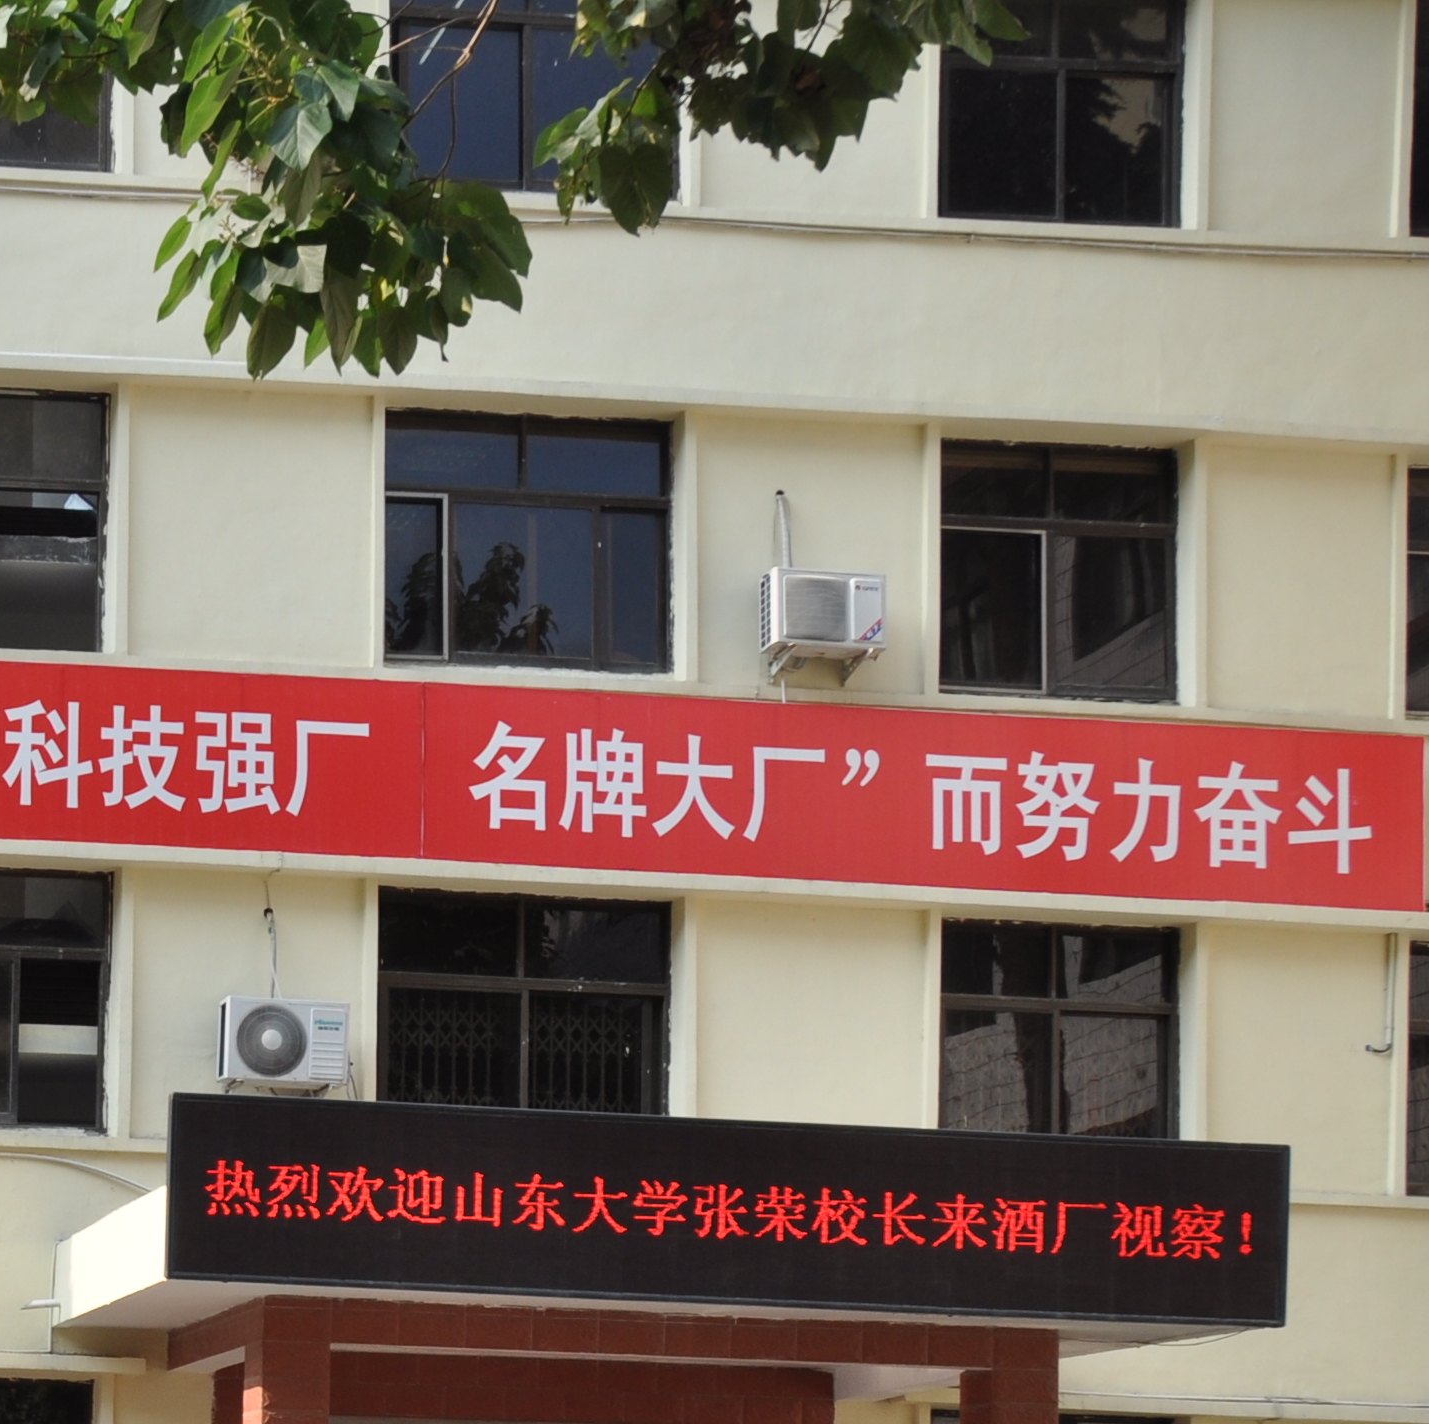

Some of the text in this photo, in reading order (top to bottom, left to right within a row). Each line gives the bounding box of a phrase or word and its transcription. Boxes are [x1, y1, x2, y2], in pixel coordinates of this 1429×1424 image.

[3, 699, 370, 817] 科技强厂
[204, 1159, 1254, 1260] 热烈欢迎山东大学张荣校长来酒厂视察！
